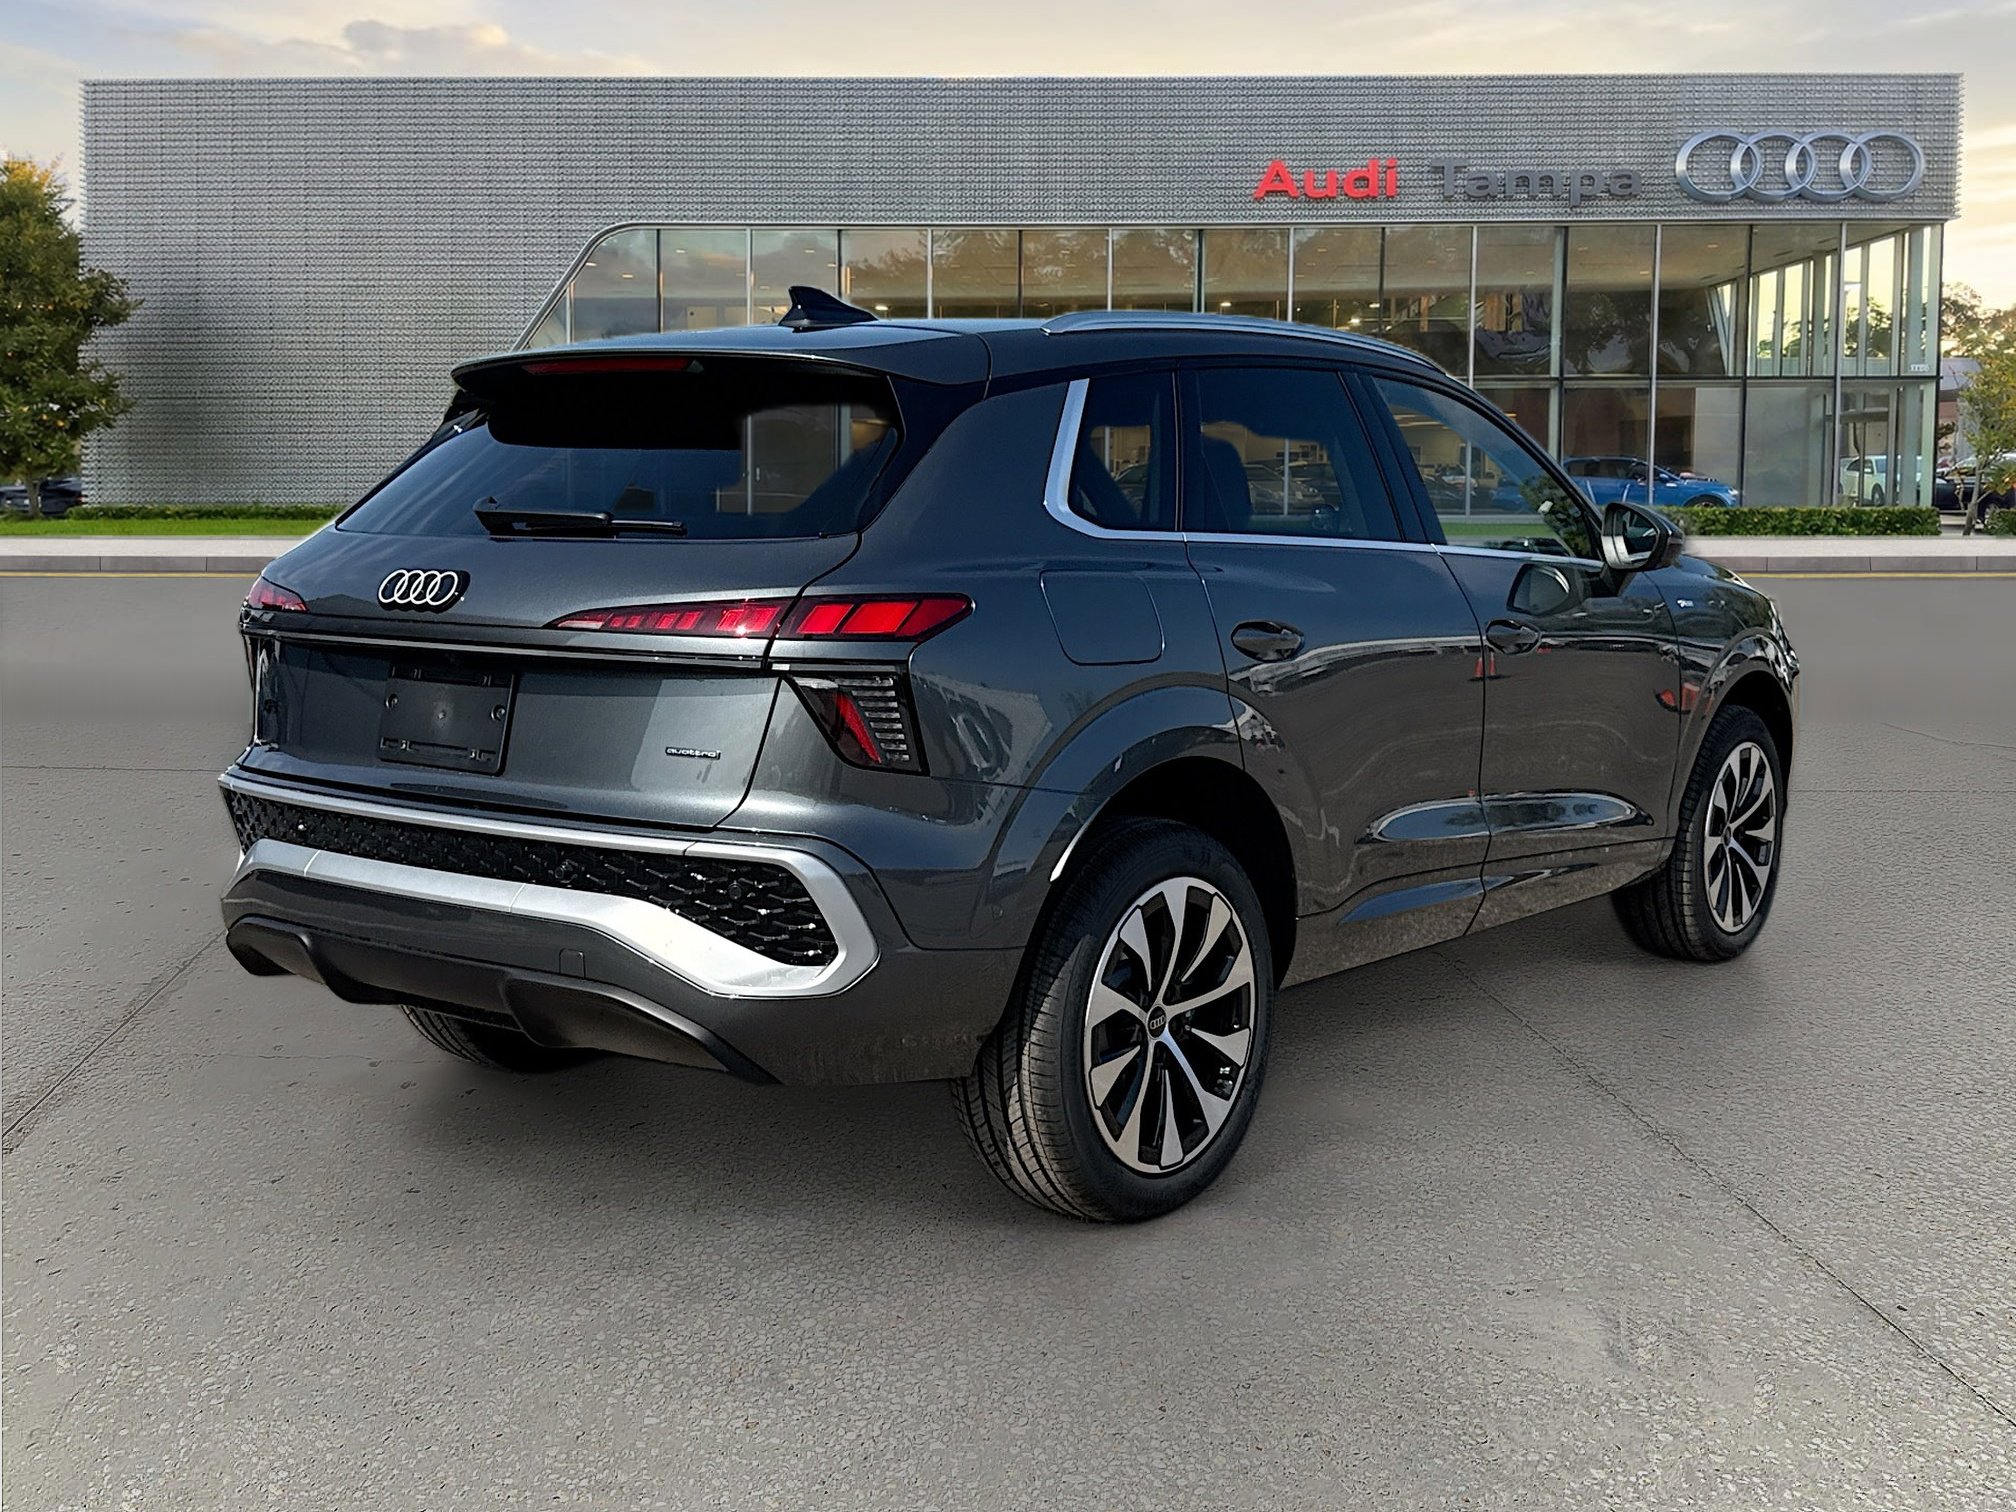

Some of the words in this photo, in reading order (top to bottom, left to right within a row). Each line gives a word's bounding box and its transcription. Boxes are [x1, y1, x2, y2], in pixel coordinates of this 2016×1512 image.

[1254, 158, 1397, 199] Audi
[1431, 158, 1643, 207] Tampa
[666, 747, 718, 759] quattro
